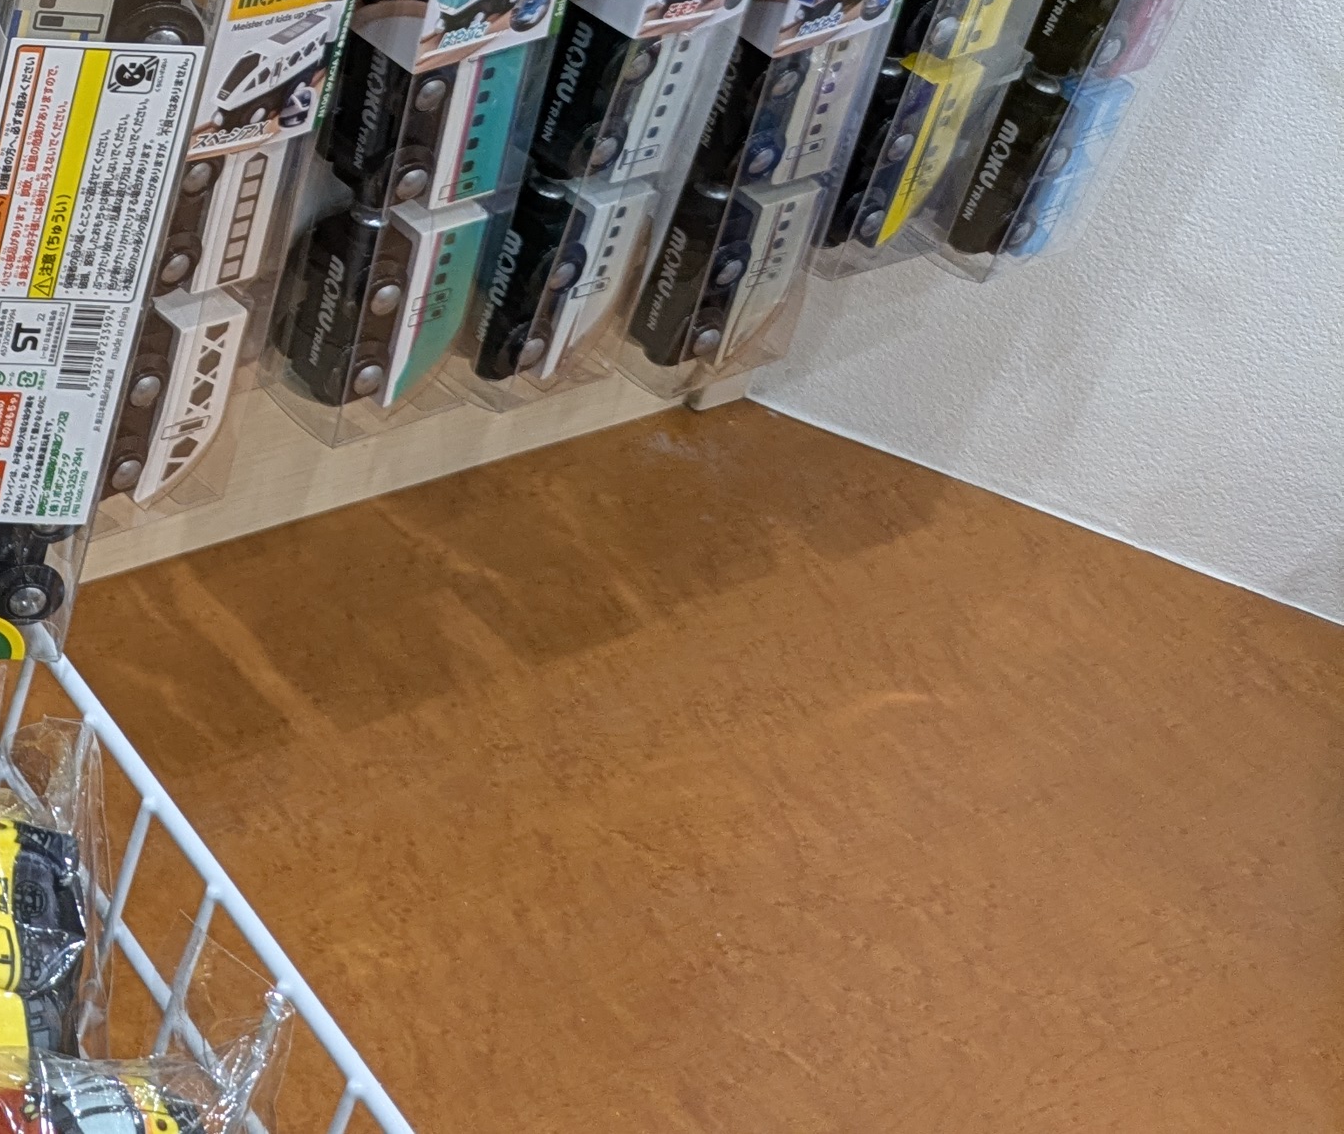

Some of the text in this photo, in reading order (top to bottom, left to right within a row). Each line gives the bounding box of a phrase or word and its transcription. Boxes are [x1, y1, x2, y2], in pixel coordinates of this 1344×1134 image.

[961, 118, 1019, 221] MOKU TRAIN
[109, 337, 122, 359] made
[117, 306, 130, 326] china
